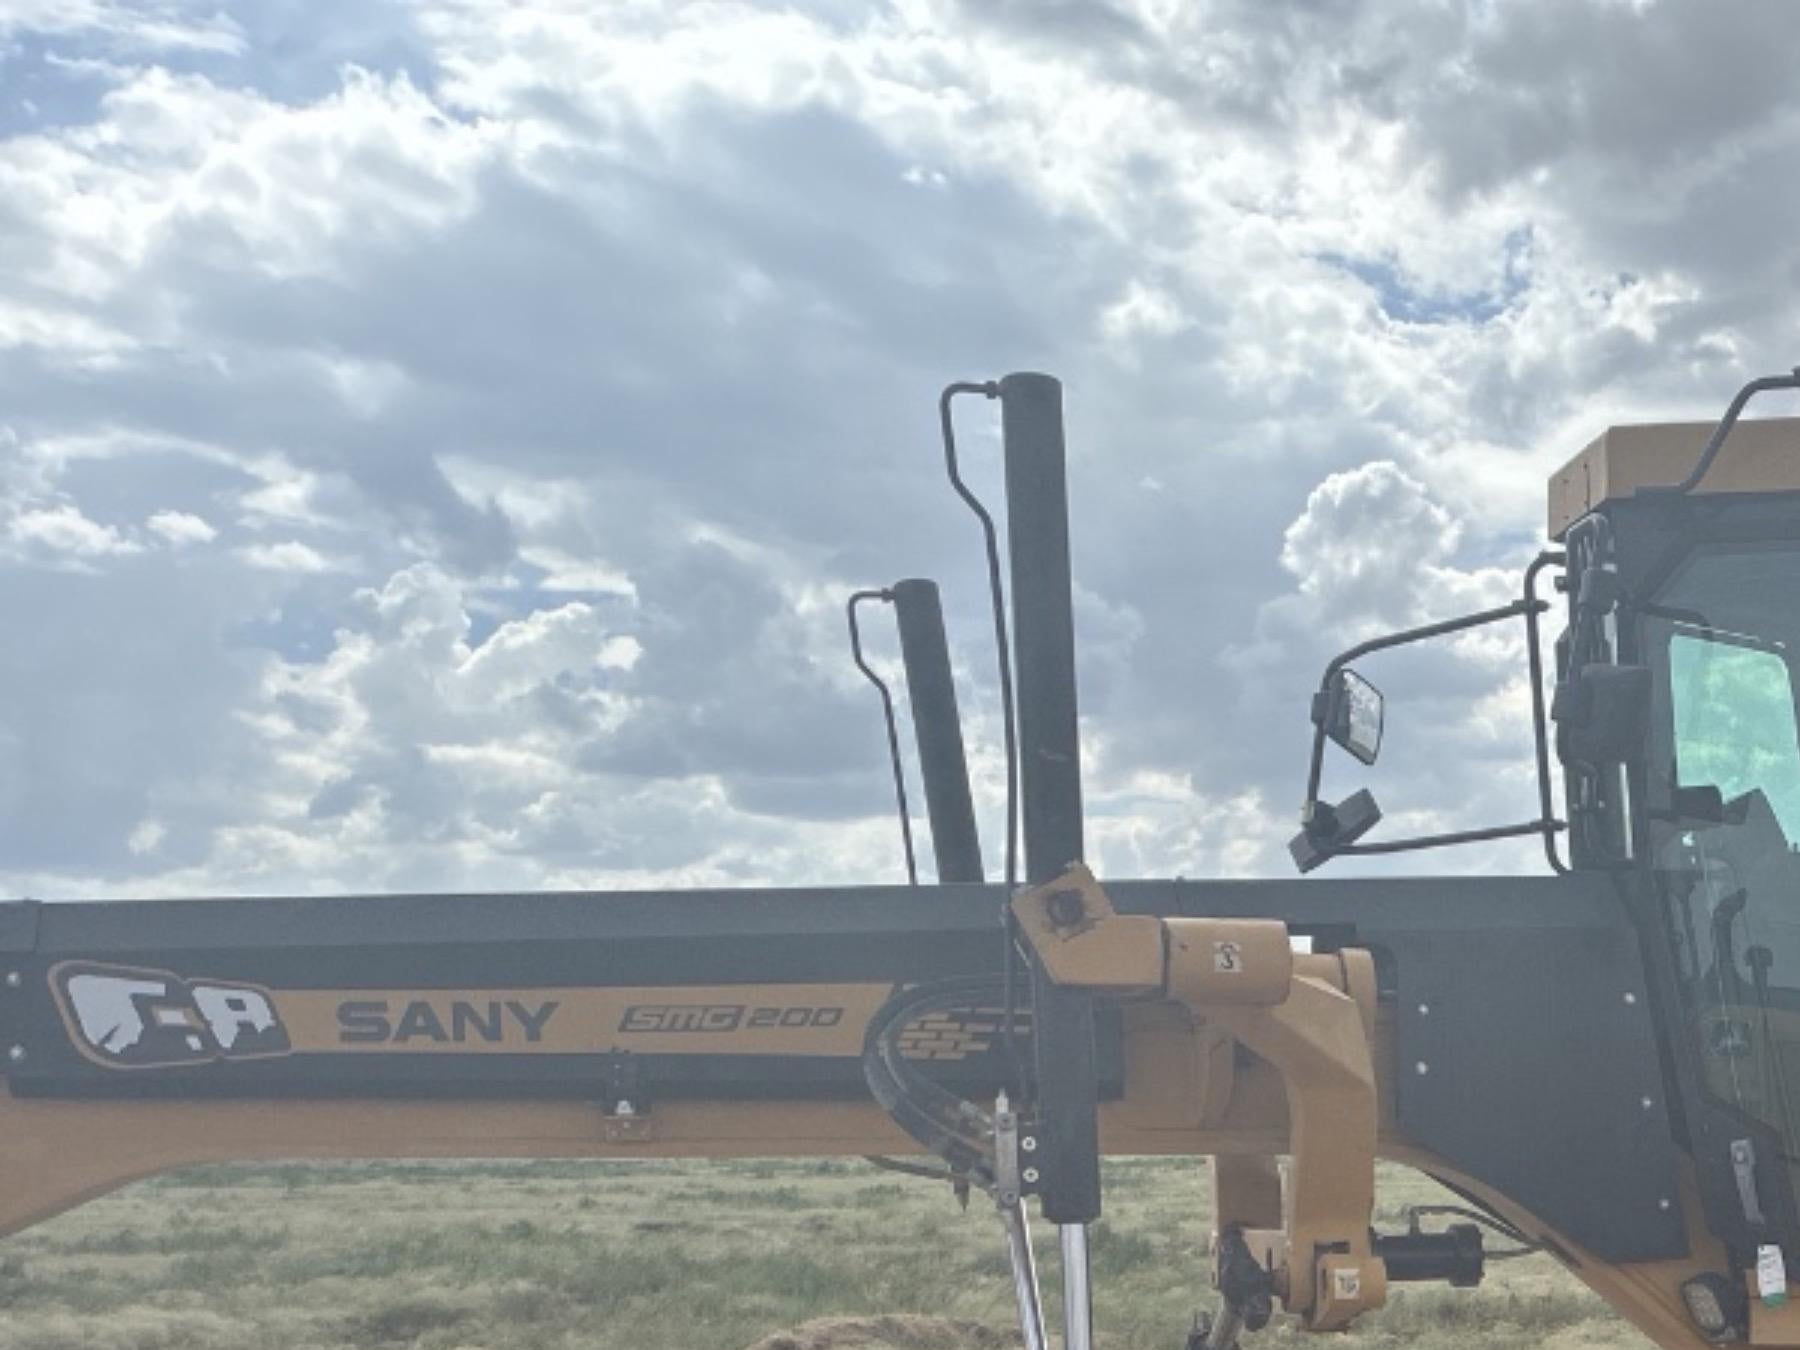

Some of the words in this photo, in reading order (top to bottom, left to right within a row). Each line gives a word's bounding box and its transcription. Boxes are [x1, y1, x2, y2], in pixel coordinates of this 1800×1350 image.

[336, 1001, 560, 1042] SANY
[618, 1004, 746, 1033] SMG
[746, 1007, 845, 1029] 200
